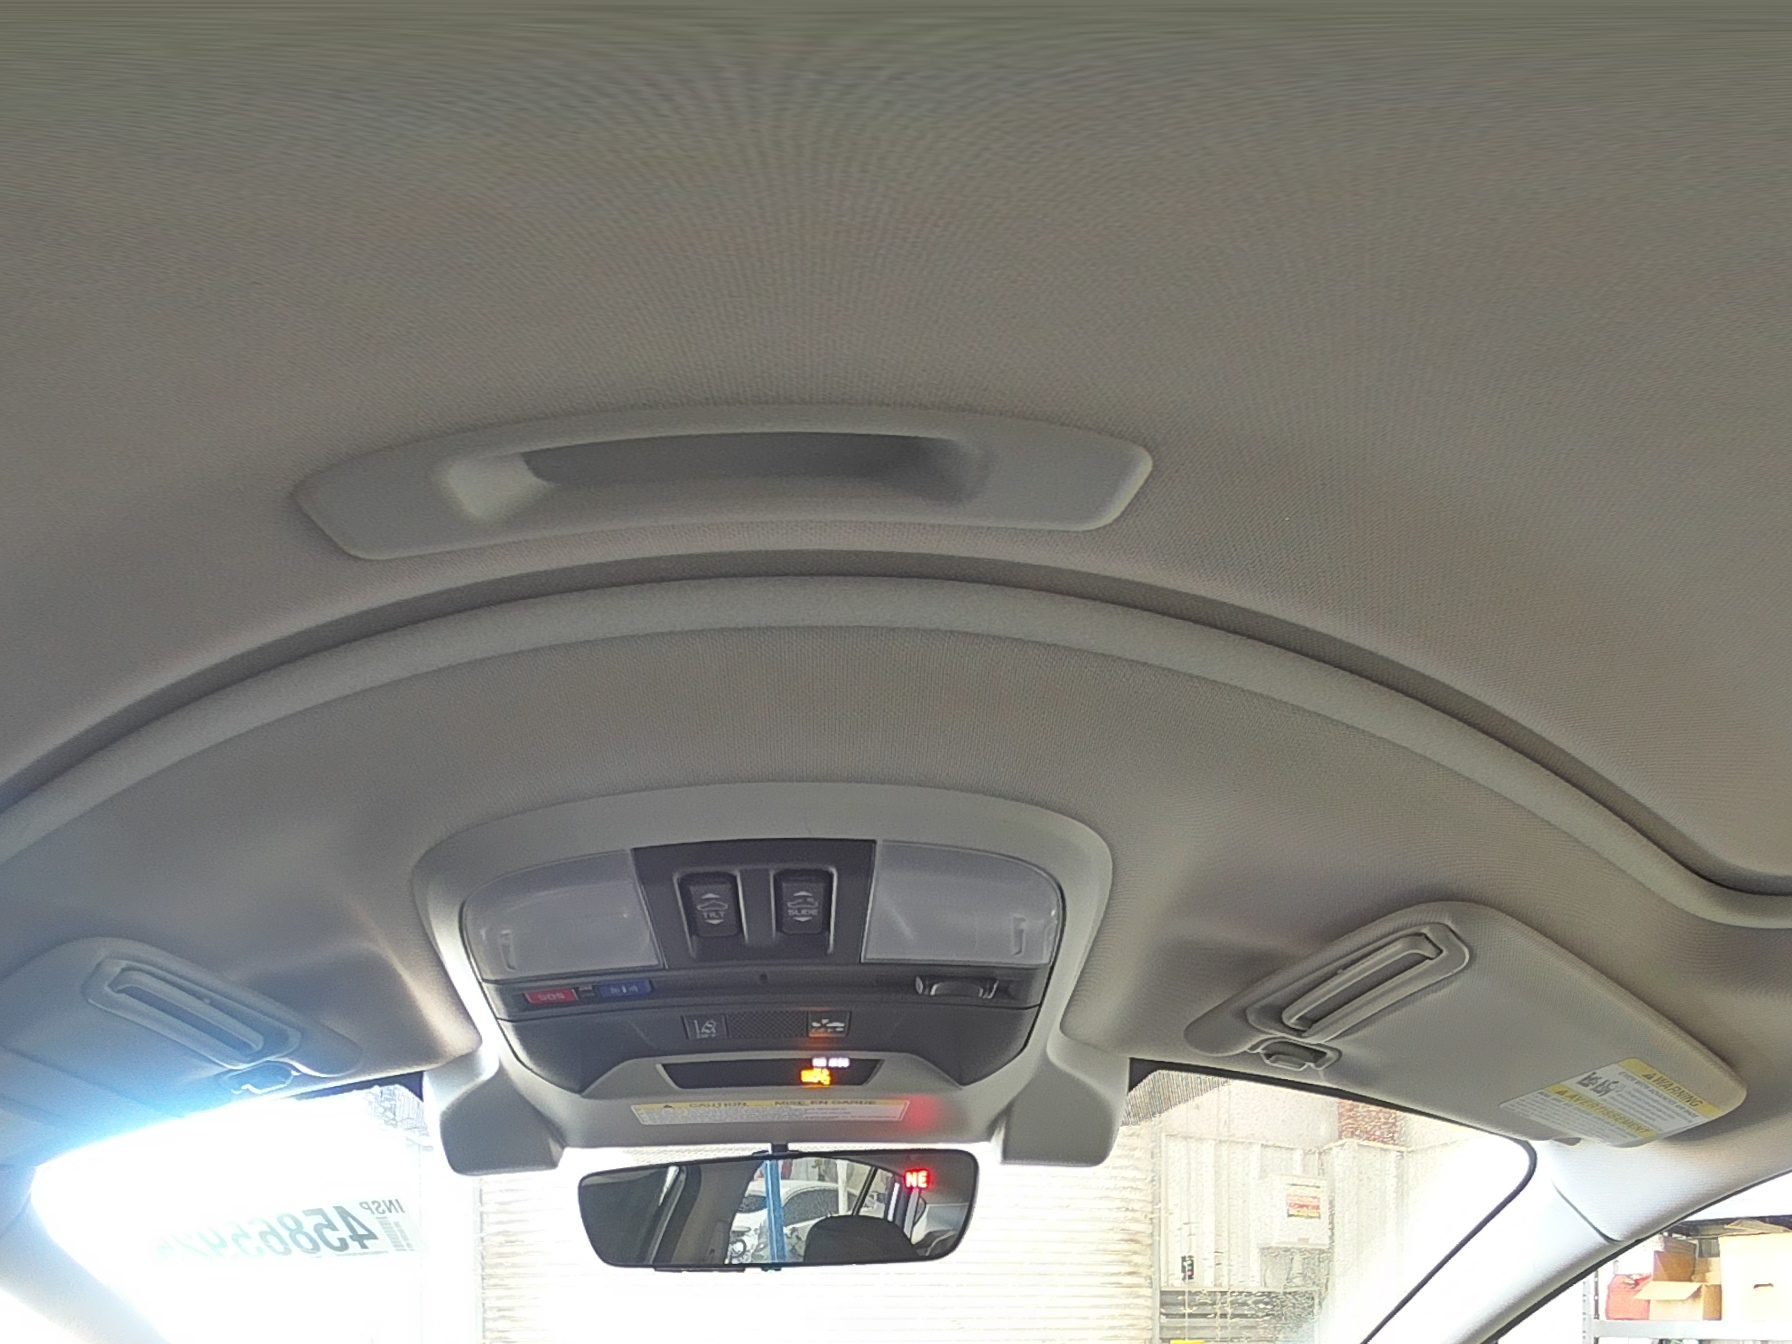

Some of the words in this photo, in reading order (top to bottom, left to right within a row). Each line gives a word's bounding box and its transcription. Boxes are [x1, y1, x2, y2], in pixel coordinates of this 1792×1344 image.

[702, 911, 726, 919] TILT
[1651, 1073, 1703, 1108] WARNING
[1563, 1088, 1652, 1135] AVERTISSEMENT
[906, 1170, 928, 1188] NE
